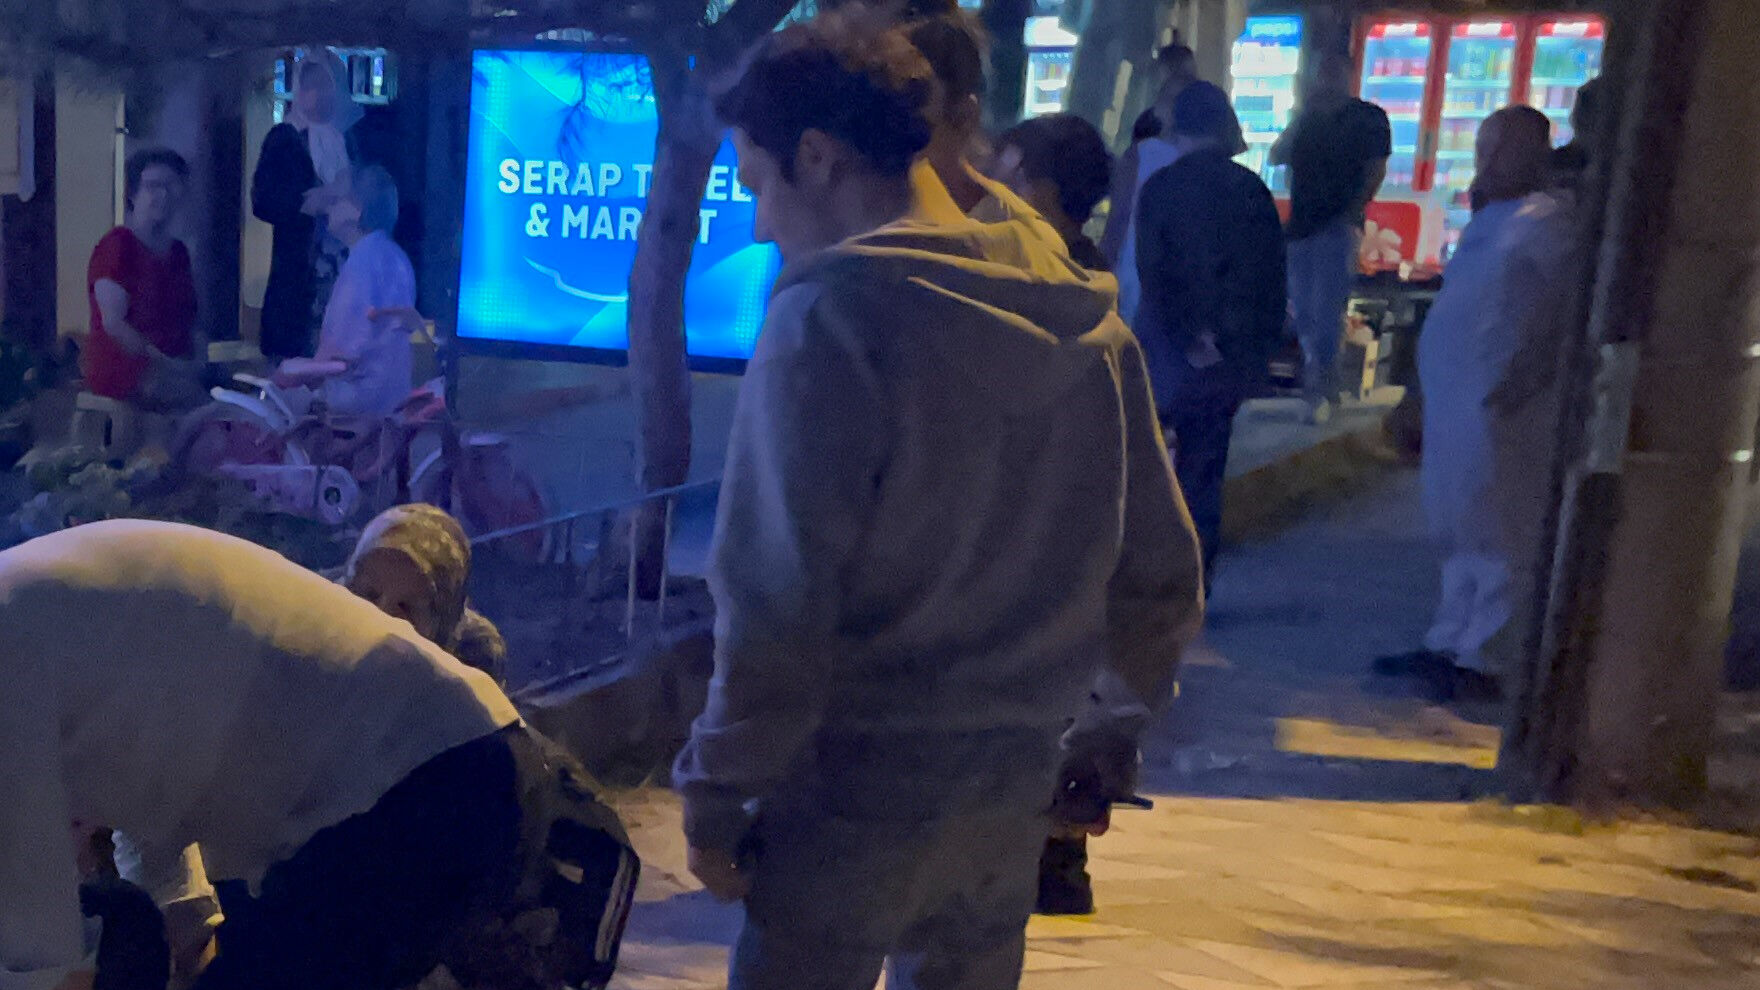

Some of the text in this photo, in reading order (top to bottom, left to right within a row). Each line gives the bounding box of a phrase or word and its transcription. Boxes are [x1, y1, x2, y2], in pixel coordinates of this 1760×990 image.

[497, 158, 752, 203] SERAP TEL
[524, 203, 717, 244] & MART
